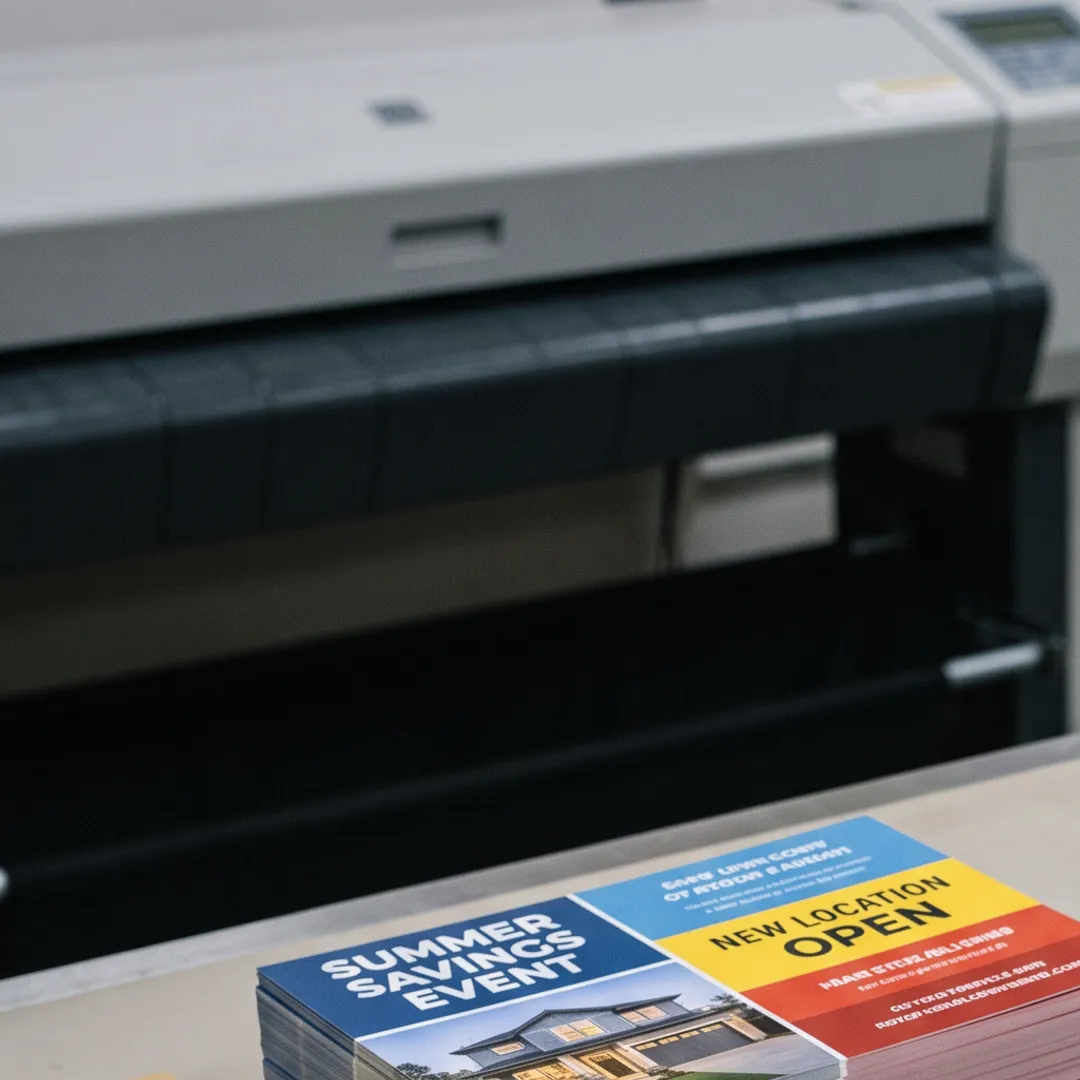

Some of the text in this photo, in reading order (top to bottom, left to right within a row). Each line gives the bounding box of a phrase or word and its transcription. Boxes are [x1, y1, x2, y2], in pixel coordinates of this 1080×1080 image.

[321, 913, 562, 980] SUMMER
[708, 920, 788, 951] NEW
[790, 875, 951, 928] LOCATION
[783, 900, 952, 958] OPEN
[346, 929, 586, 998] SAVINGS
[402, 953, 582, 1011] EVENT
